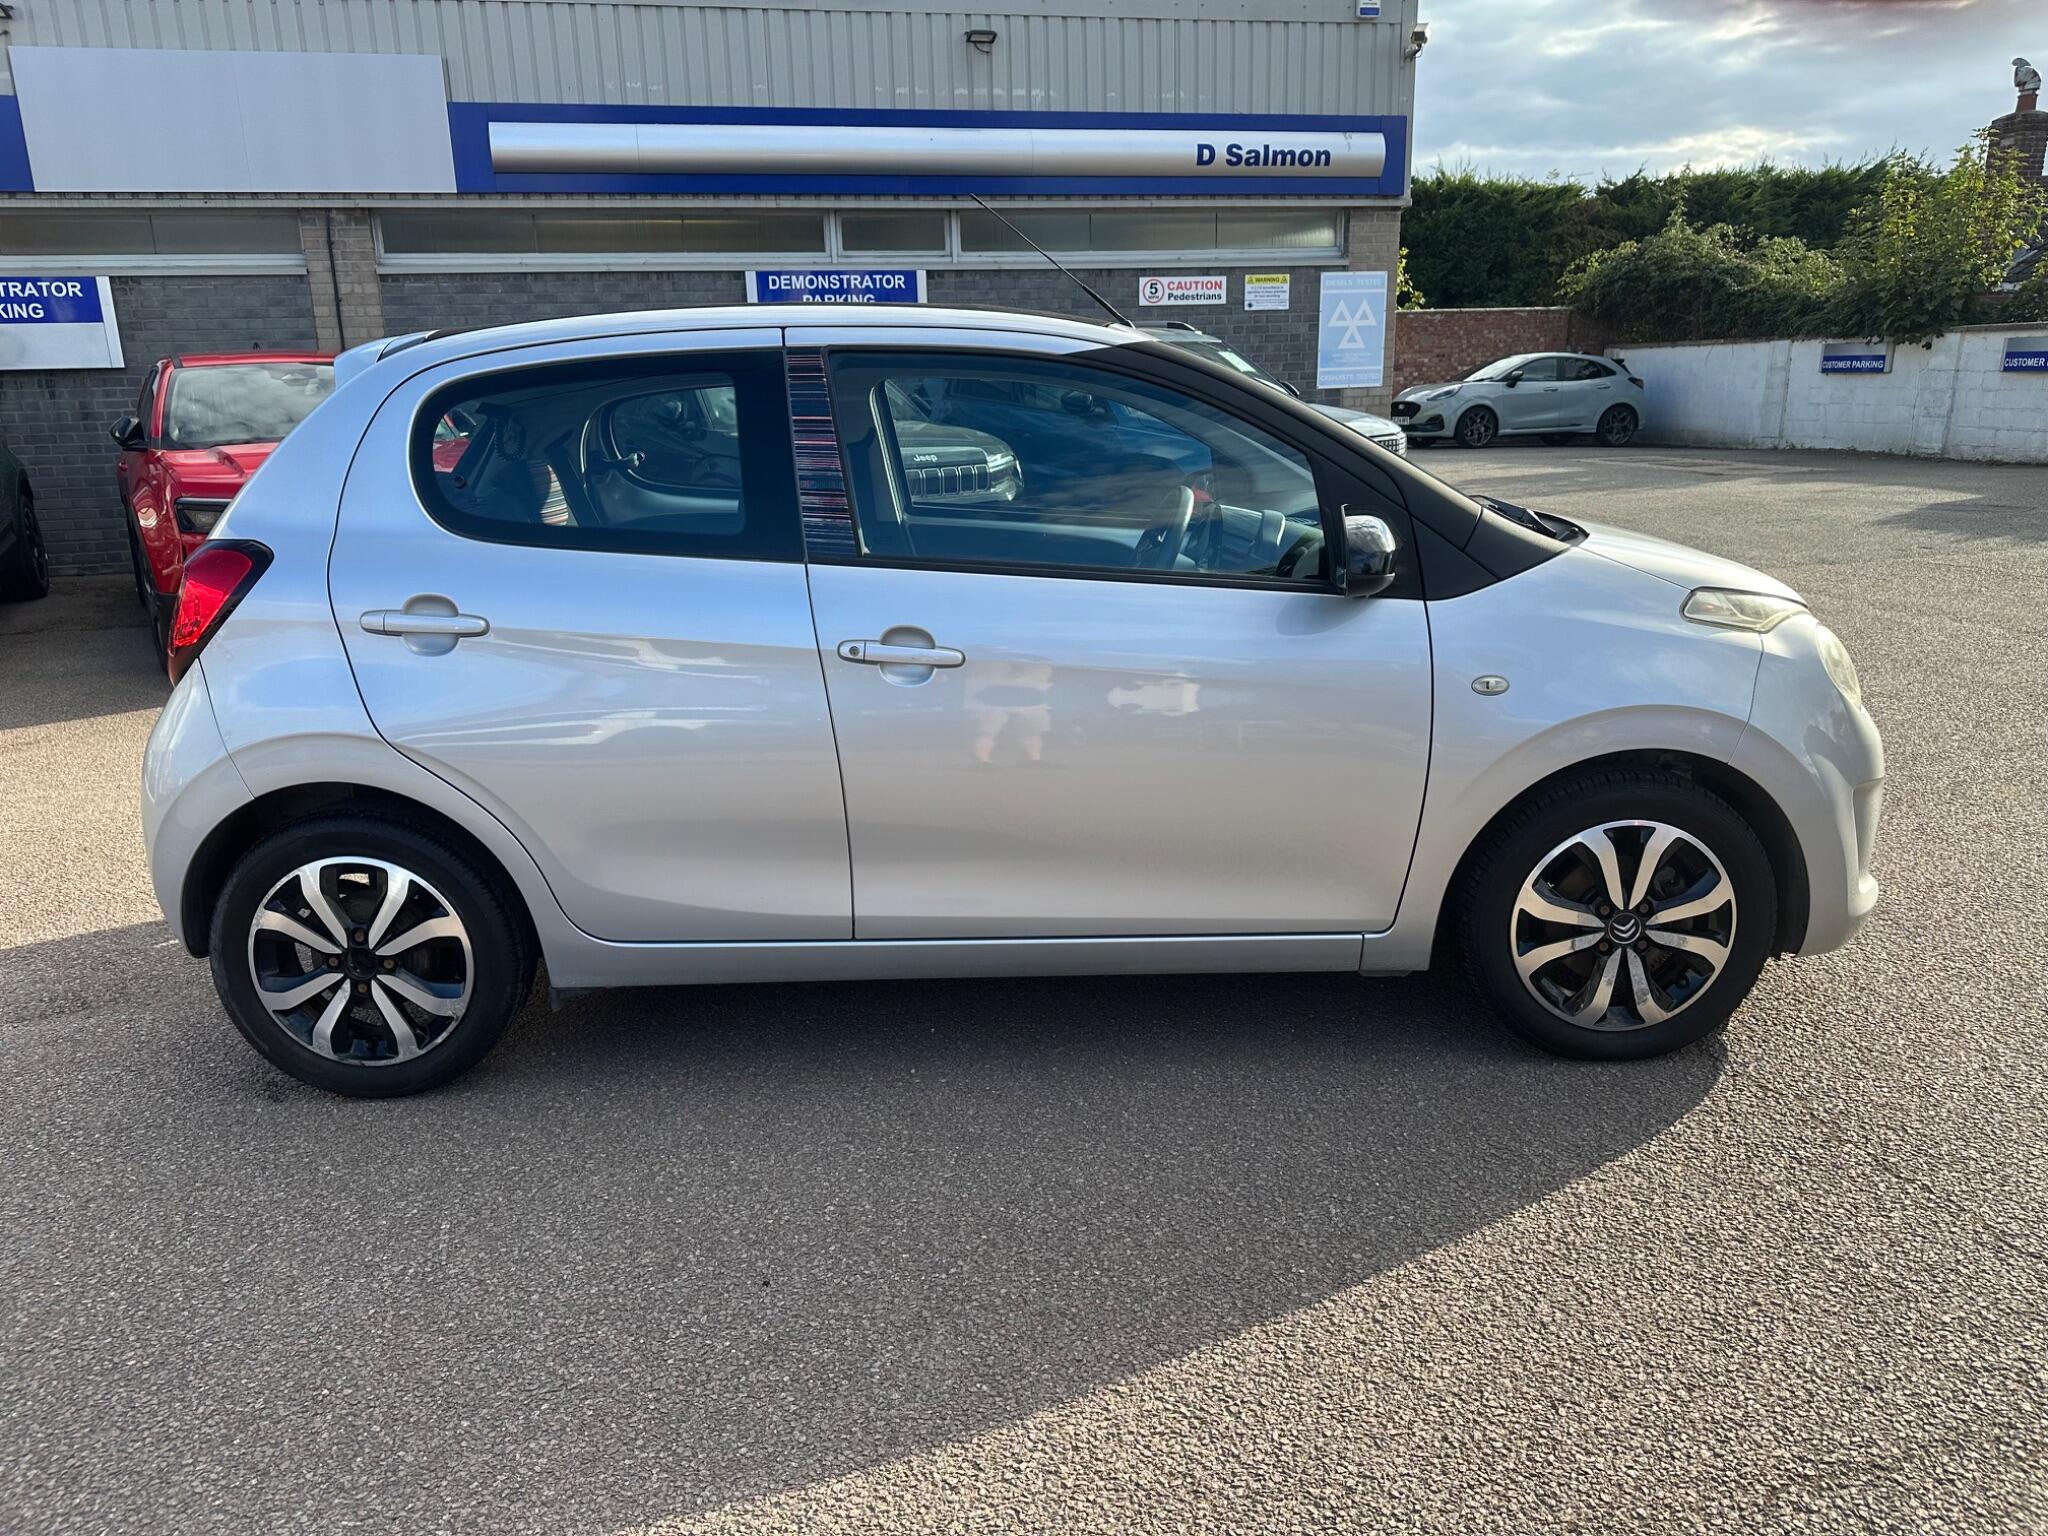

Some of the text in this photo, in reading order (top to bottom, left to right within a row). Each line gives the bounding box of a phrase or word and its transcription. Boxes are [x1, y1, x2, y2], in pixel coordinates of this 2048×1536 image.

[1196, 143, 1331, 167] D Salmon
[768, 275, 906, 290] DEMONSTRATOR
[1167, 280, 1222, 291] CAUTION
[1149, 282, 1158, 295] 5
[1167, 292, 1222, 301] Pedestrians
[1822, 360, 1884, 369] CUSTOMER PARKING
[2004, 357, 2046, 367] CUSTOMER
[913, 454, 938, 463] Jeep
